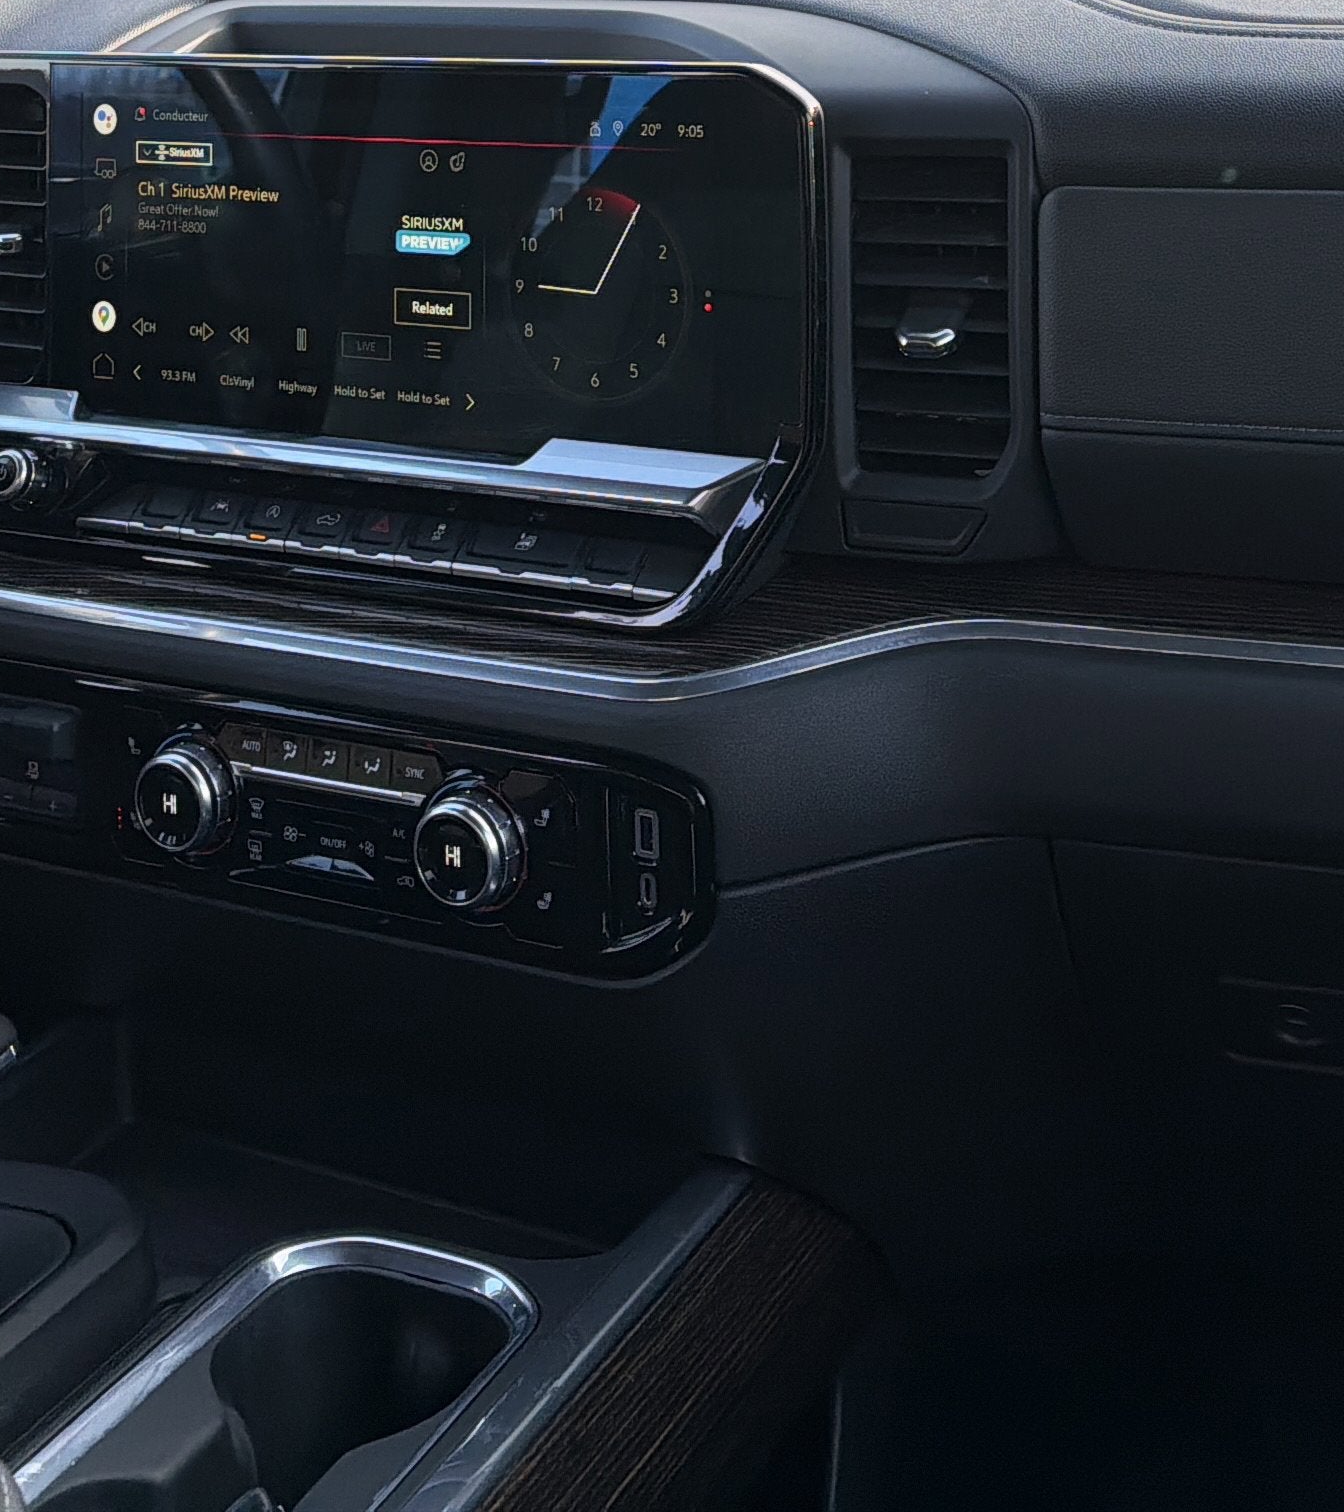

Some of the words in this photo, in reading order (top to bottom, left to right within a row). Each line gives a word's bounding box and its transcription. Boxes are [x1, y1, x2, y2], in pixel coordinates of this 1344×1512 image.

[152, 109, 209, 122] Conducteur
[677, 124, 705, 138] 9:05
[169, 147, 205, 158] SiriusXM
[138, 181, 155, 196] Ch
[158, 182, 164, 196] 1
[172, 183, 226, 199] SiriusXM
[229, 185, 280, 202] Preview
[138, 202, 164, 214] Great
[587, 197, 604, 212] 12
[550, 207, 564, 222] 11
[401, 215, 464, 231] SIRIUSXM
[401, 234, 464, 250] PREVIEW
[521, 236, 538, 252] 10
[658, 245, 668, 260] 2
[515, 279, 525, 294] 9
[669, 289, 679, 304] 3
[412, 301, 453, 316] Related
[143, 322, 156, 334] CH
[189, 325, 203, 337] CH
[524, 322, 534, 338] 8
[657, 333, 667, 348] 4
[552, 356, 561, 371] 7
[629, 363, 639, 378] 5
[161, 369, 181, 382] 93.3
[182, 371, 196, 382] FM
[590, 372, 600, 388] 6
[278, 379, 318, 397] Highway
[334, 384, 356, 397] Hold
[357, 388, 368, 399] to
[370, 388, 386, 400] Set
[397, 390, 420, 403] Hold
[422, 394, 433, 405] to
[434, 394, 450, 406] Set
[242, 739, 261, 752] AUTO
[405, 766, 425, 780] SYNC
[162, 792, 177, 815] HI
[392, 826, 406, 839] A/C
[319, 836, 347, 849] ON/OFF
[444, 844, 461, 868] HI
